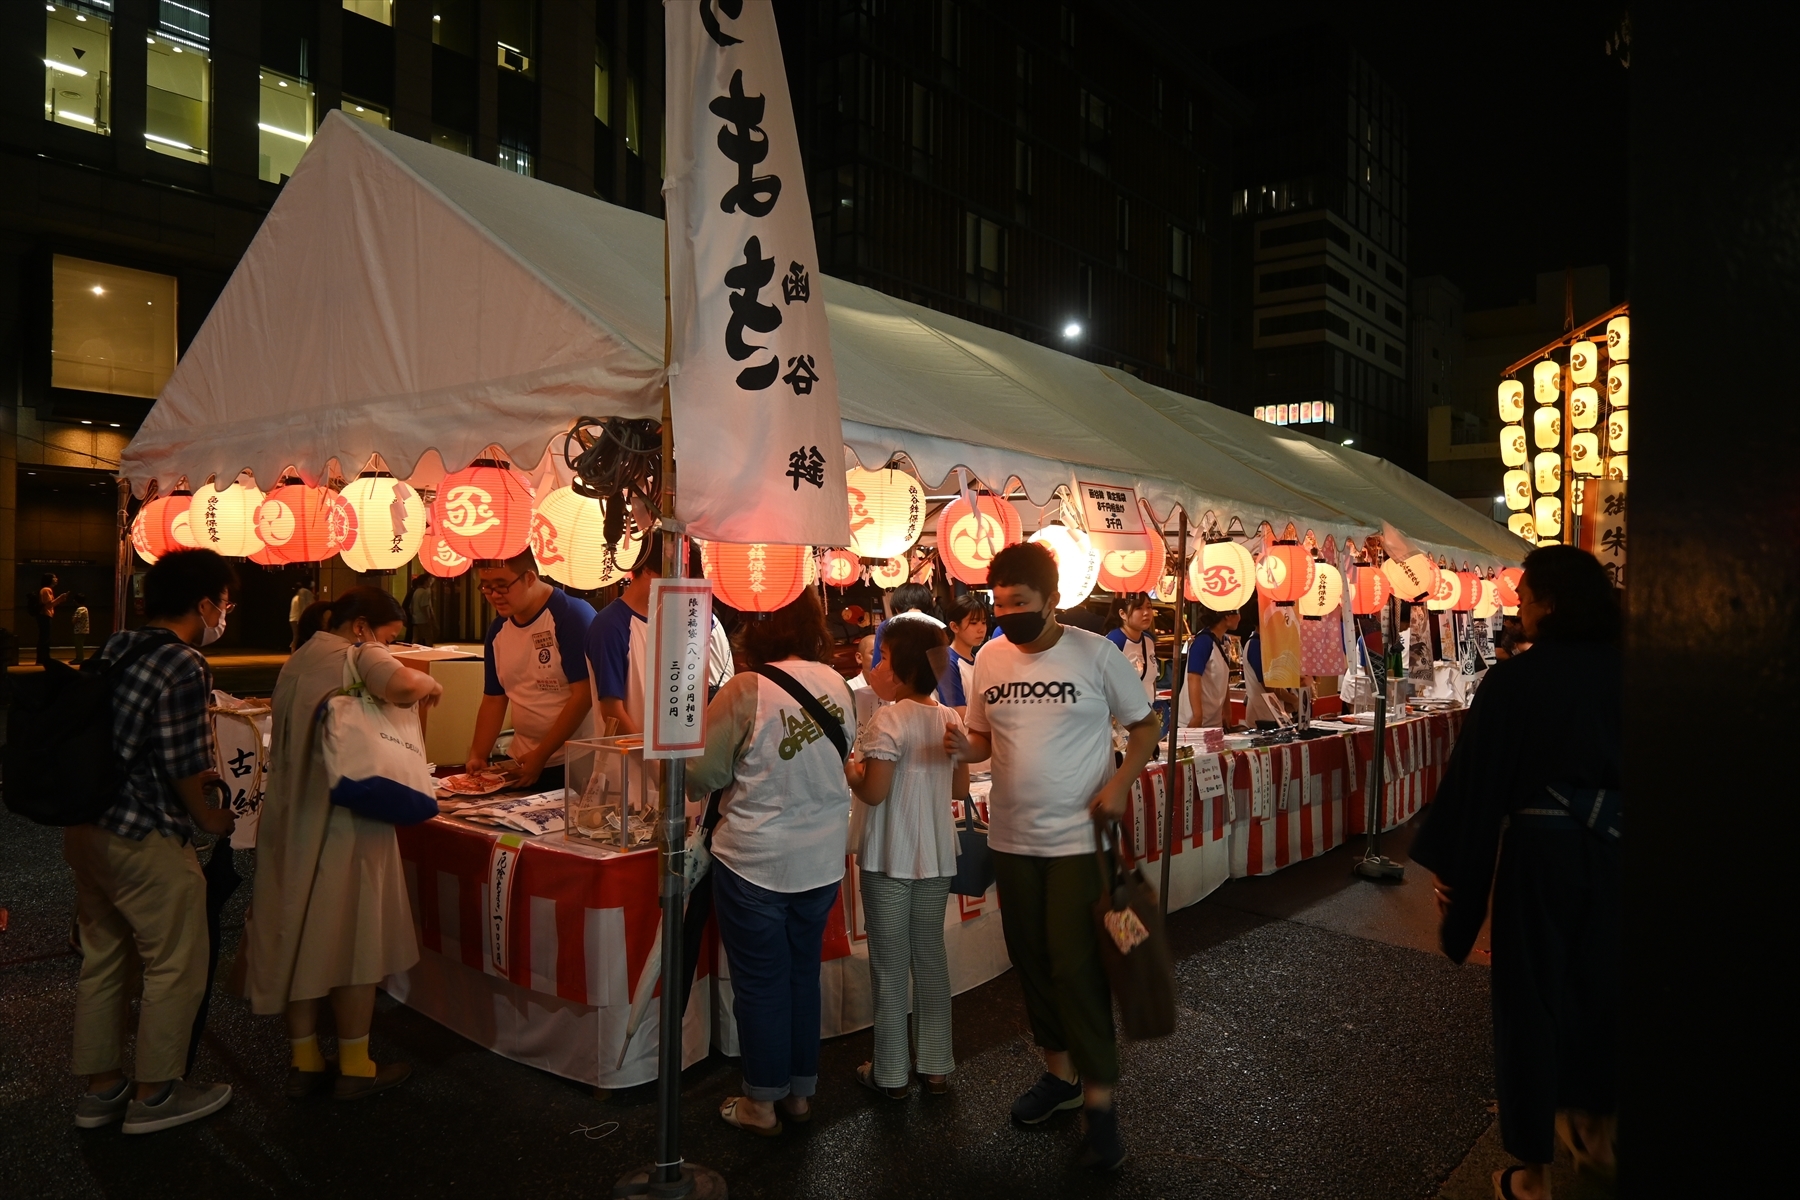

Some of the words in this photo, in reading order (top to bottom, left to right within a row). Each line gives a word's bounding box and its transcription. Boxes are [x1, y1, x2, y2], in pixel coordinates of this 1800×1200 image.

[204, 495, 221, 543] 函谷鉾保存会
[1105, 517, 1123, 530] 3千円
[984, 681, 1077, 704] OUTDOOR
